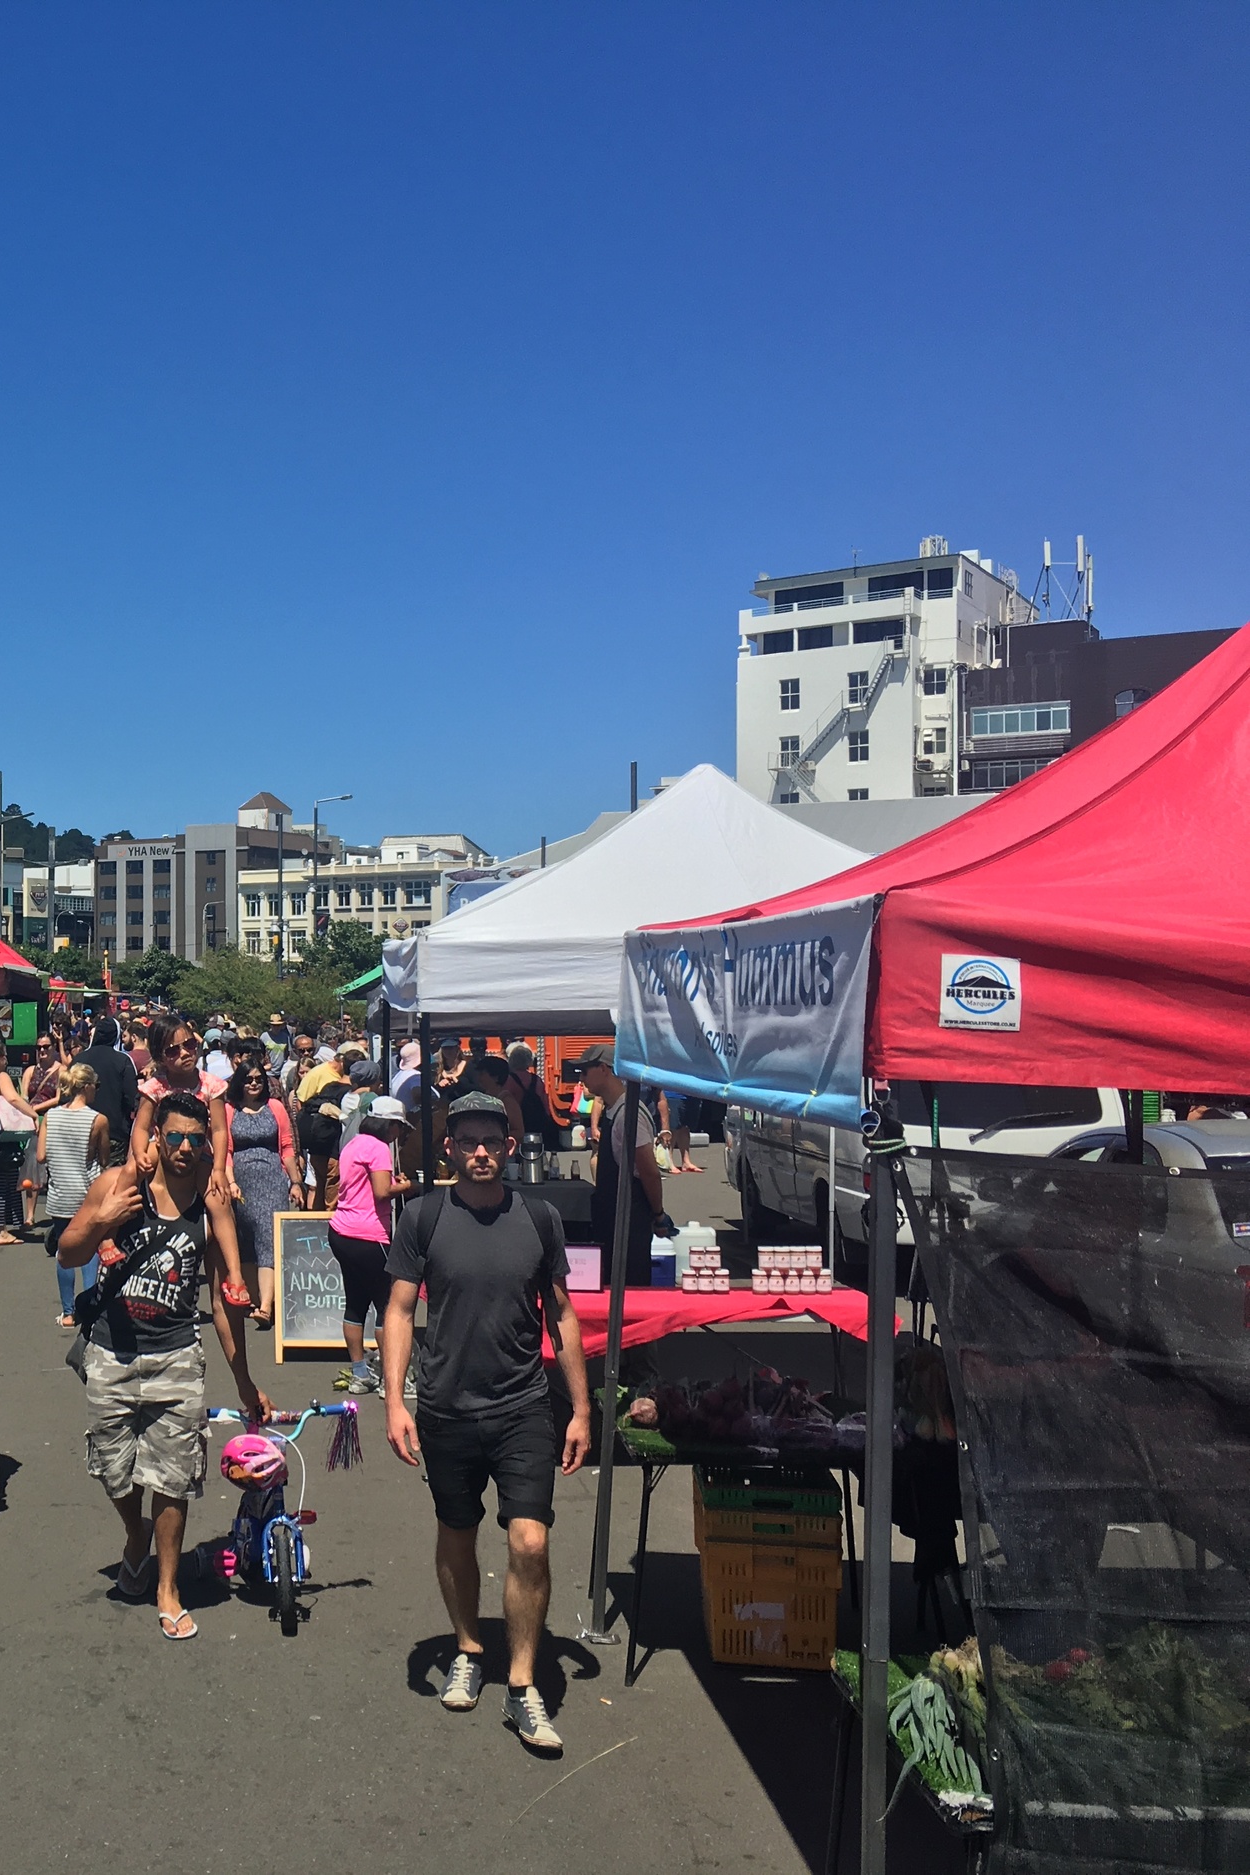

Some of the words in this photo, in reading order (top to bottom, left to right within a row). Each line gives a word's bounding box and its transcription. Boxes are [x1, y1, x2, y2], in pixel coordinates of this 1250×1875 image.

[128, 846, 147, 856] YHA
[150, 846, 170, 856] New
[946, 987, 1016, 1000] HERCULES
[966, 1000, 996, 1008] Marquee
[156, 1281, 181, 1313] LEE
